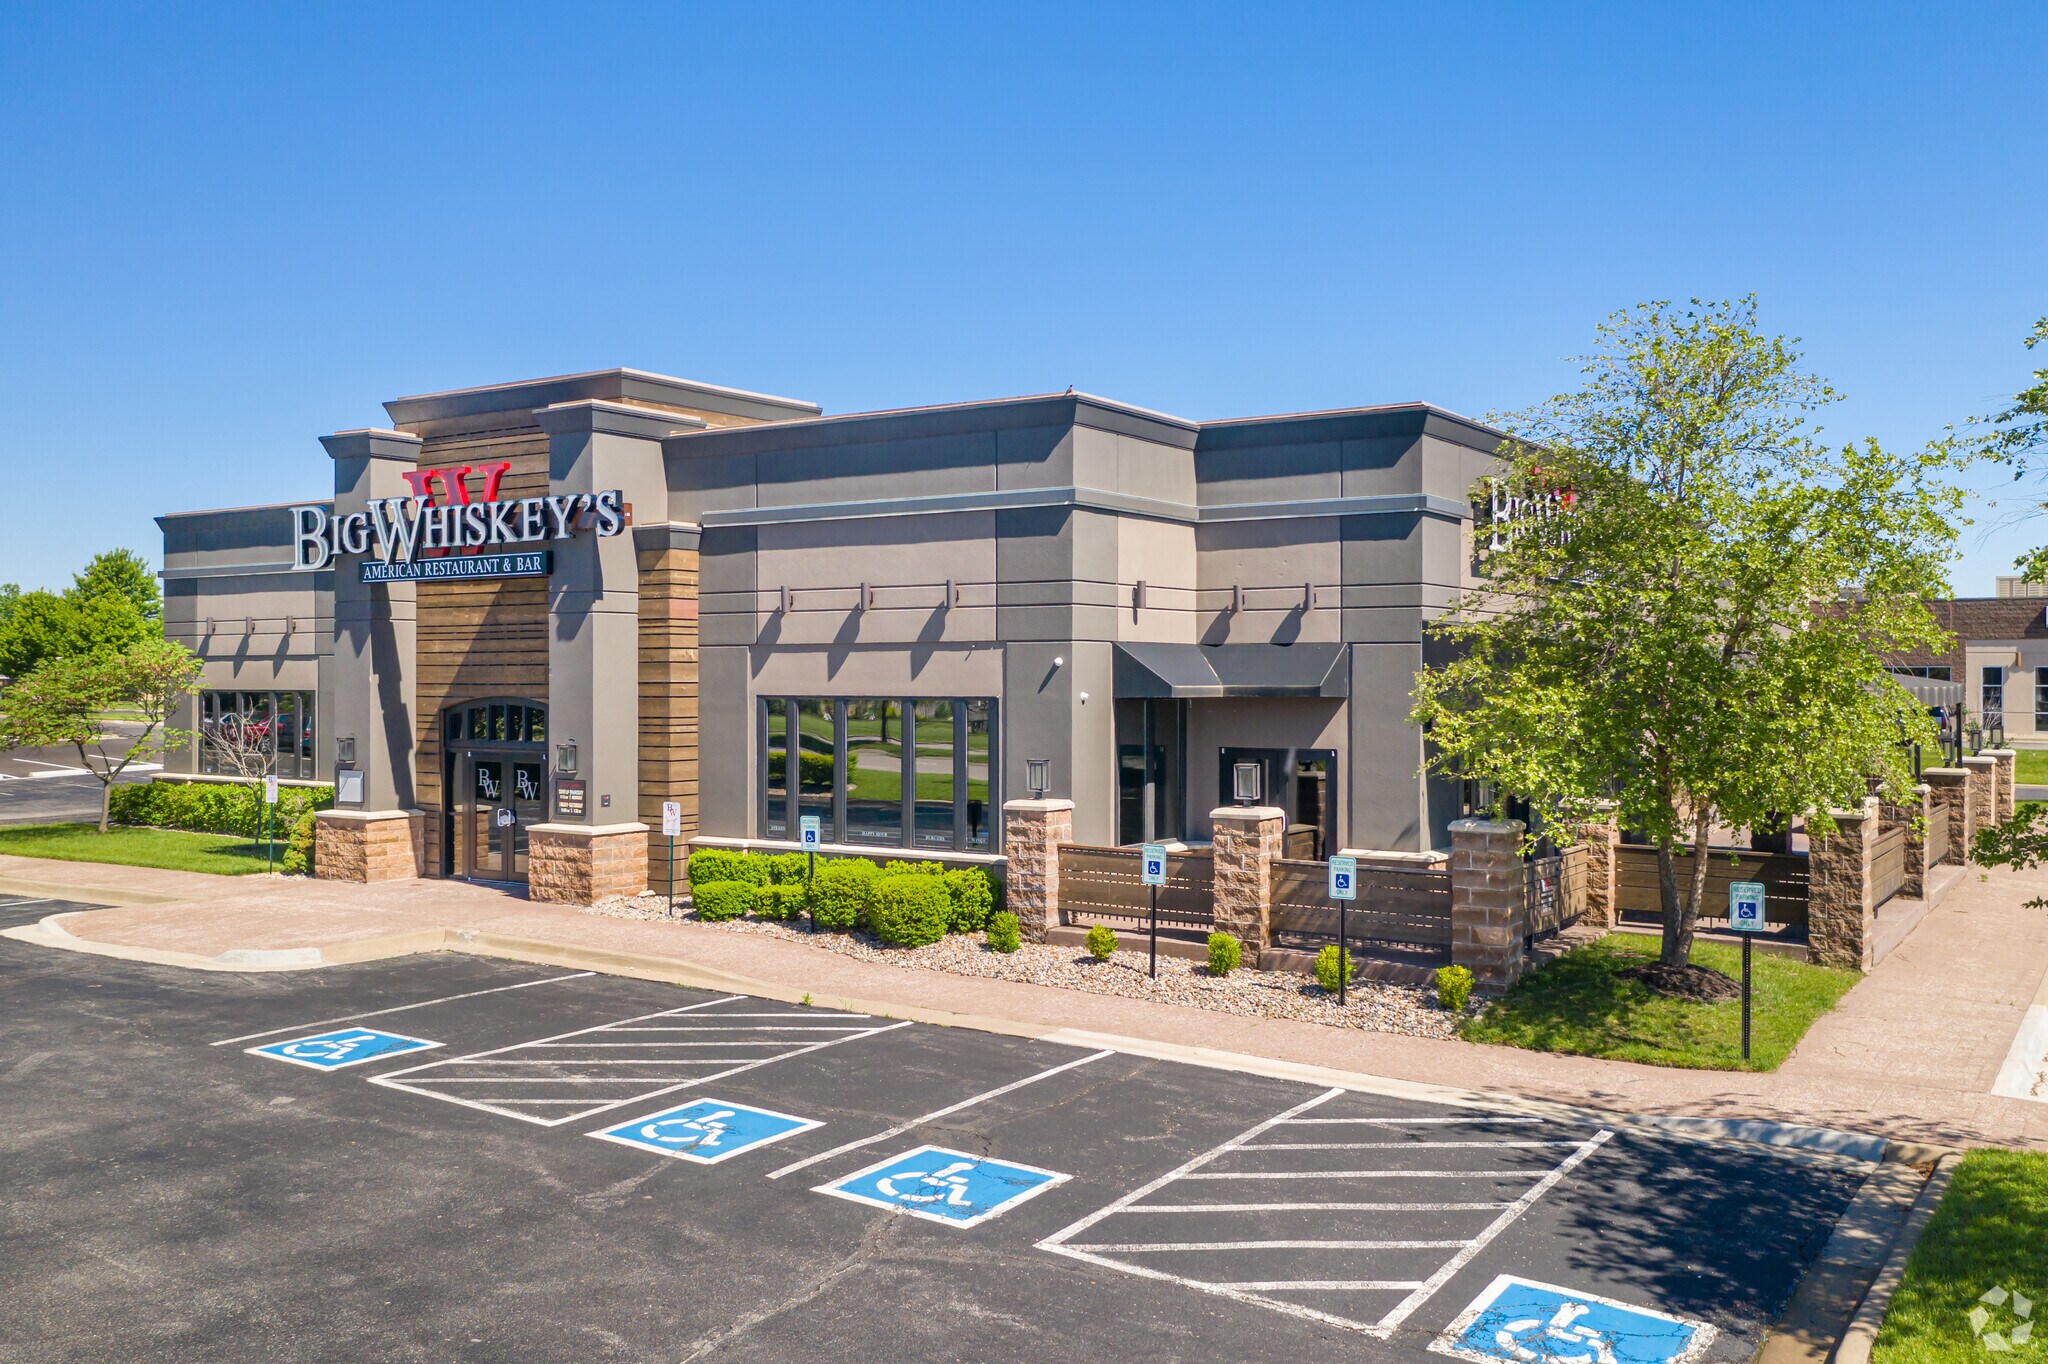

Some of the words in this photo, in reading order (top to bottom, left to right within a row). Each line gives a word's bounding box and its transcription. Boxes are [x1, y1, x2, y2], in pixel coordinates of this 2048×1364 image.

[363, 562, 421, 579] AMERICAN
[424, 558, 500, 576] RESTAURANT
[503, 558, 511, 572] &
[516, 556, 542, 572] BAR
[1331, 859, 1354, 867] RESERVED
[1733, 886, 1762, 894] RESERVED
[1735, 893, 1760, 901] PARKING
